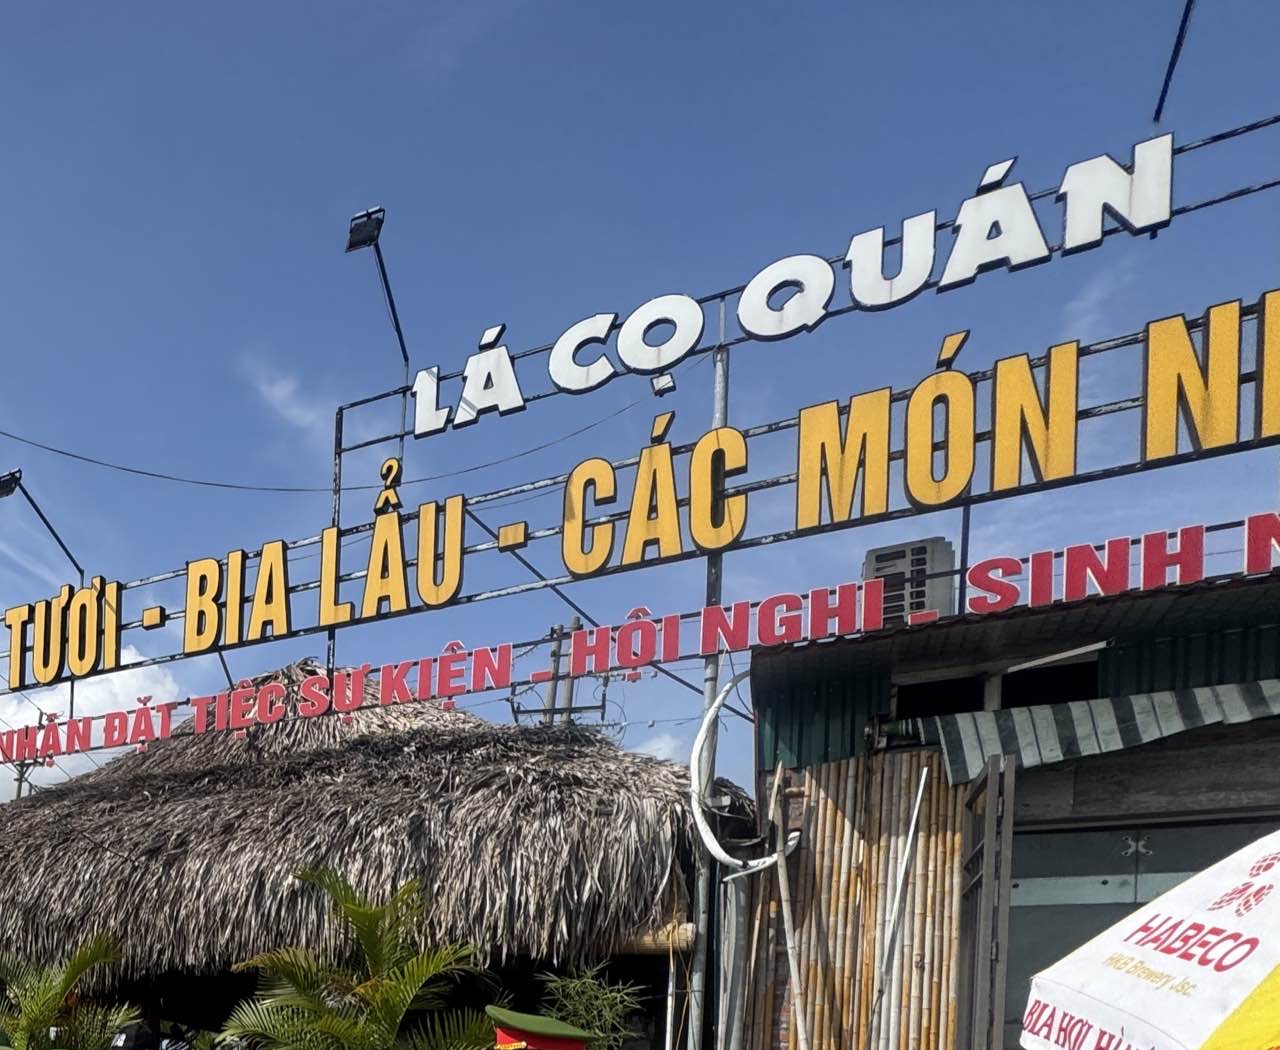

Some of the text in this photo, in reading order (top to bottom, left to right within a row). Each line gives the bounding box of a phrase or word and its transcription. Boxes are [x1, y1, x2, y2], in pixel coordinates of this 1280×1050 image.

[411, 131, 1175, 438] LÁ CỌ QUÁN
[5, 576, 120, 690] TƯƠI
[184, 540, 291, 655] BIA
[320, 457, 466, 628] LẨU
[562, 411, 749, 577] CÁC
[797, 330, 1080, 532] MÓN
[1141, 287, 1280, 462] N
[104, 696, 178, 753] ĐẶT
[191, 679, 287, 740] TIỆC
[299, 664, 369, 724] SỰ
[571, 607, 681, 682] HỘI
[966, 524, 1205, 614] SINH
[1021, 1000, 1057, 1041] BIA
[1124, 913, 1260, 972] HABECO
